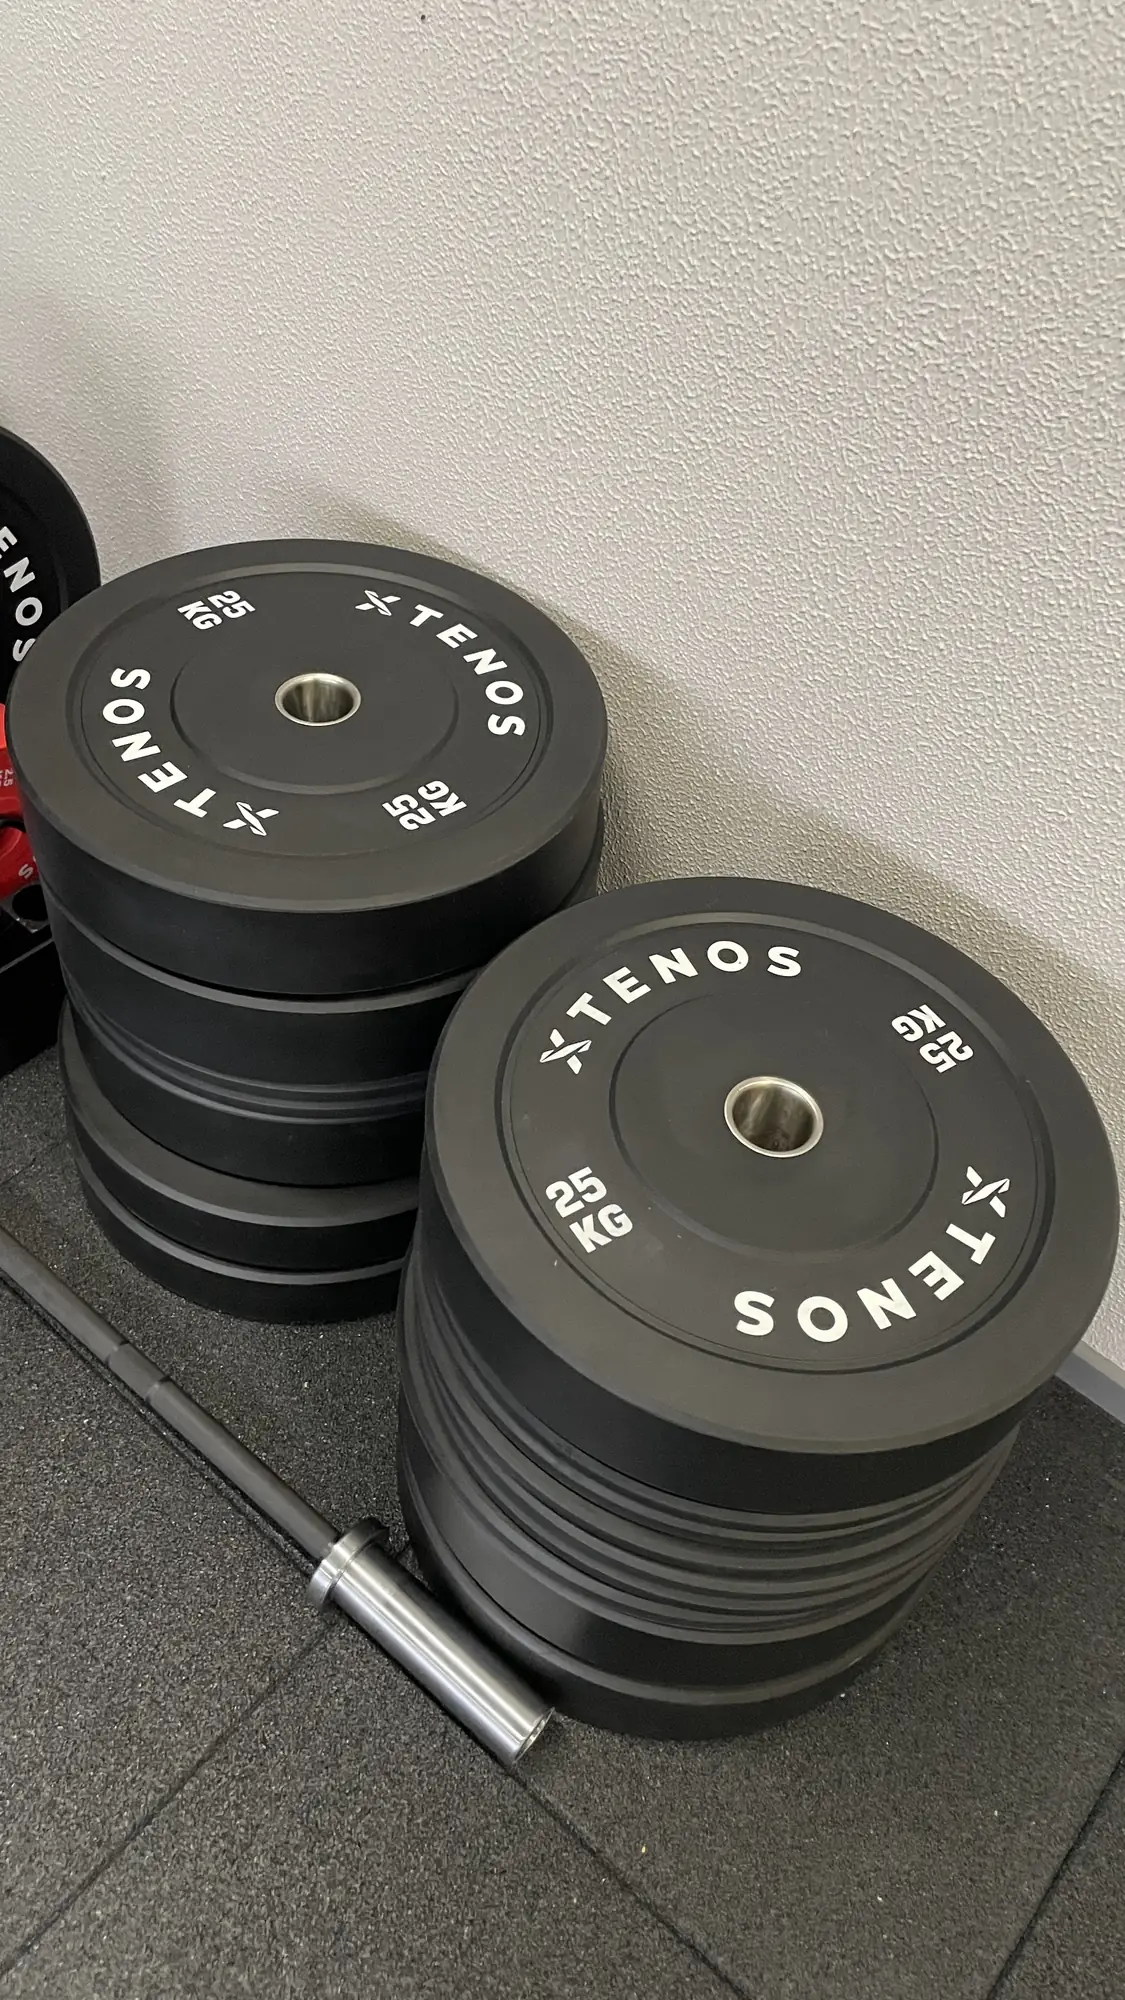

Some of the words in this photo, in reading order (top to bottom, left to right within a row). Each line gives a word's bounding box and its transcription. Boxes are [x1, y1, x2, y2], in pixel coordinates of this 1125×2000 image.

[177, 600, 223, 630] KG
[208, 590, 256, 619] 25
[381, 794, 437, 831] 25
[417, 780, 468, 817] KG
[891, 1004, 947, 1042] KG
[919, 1030, 974, 1074] 25
[545, 1166, 608, 1219] 25
[568, 1203, 634, 1254] KG
